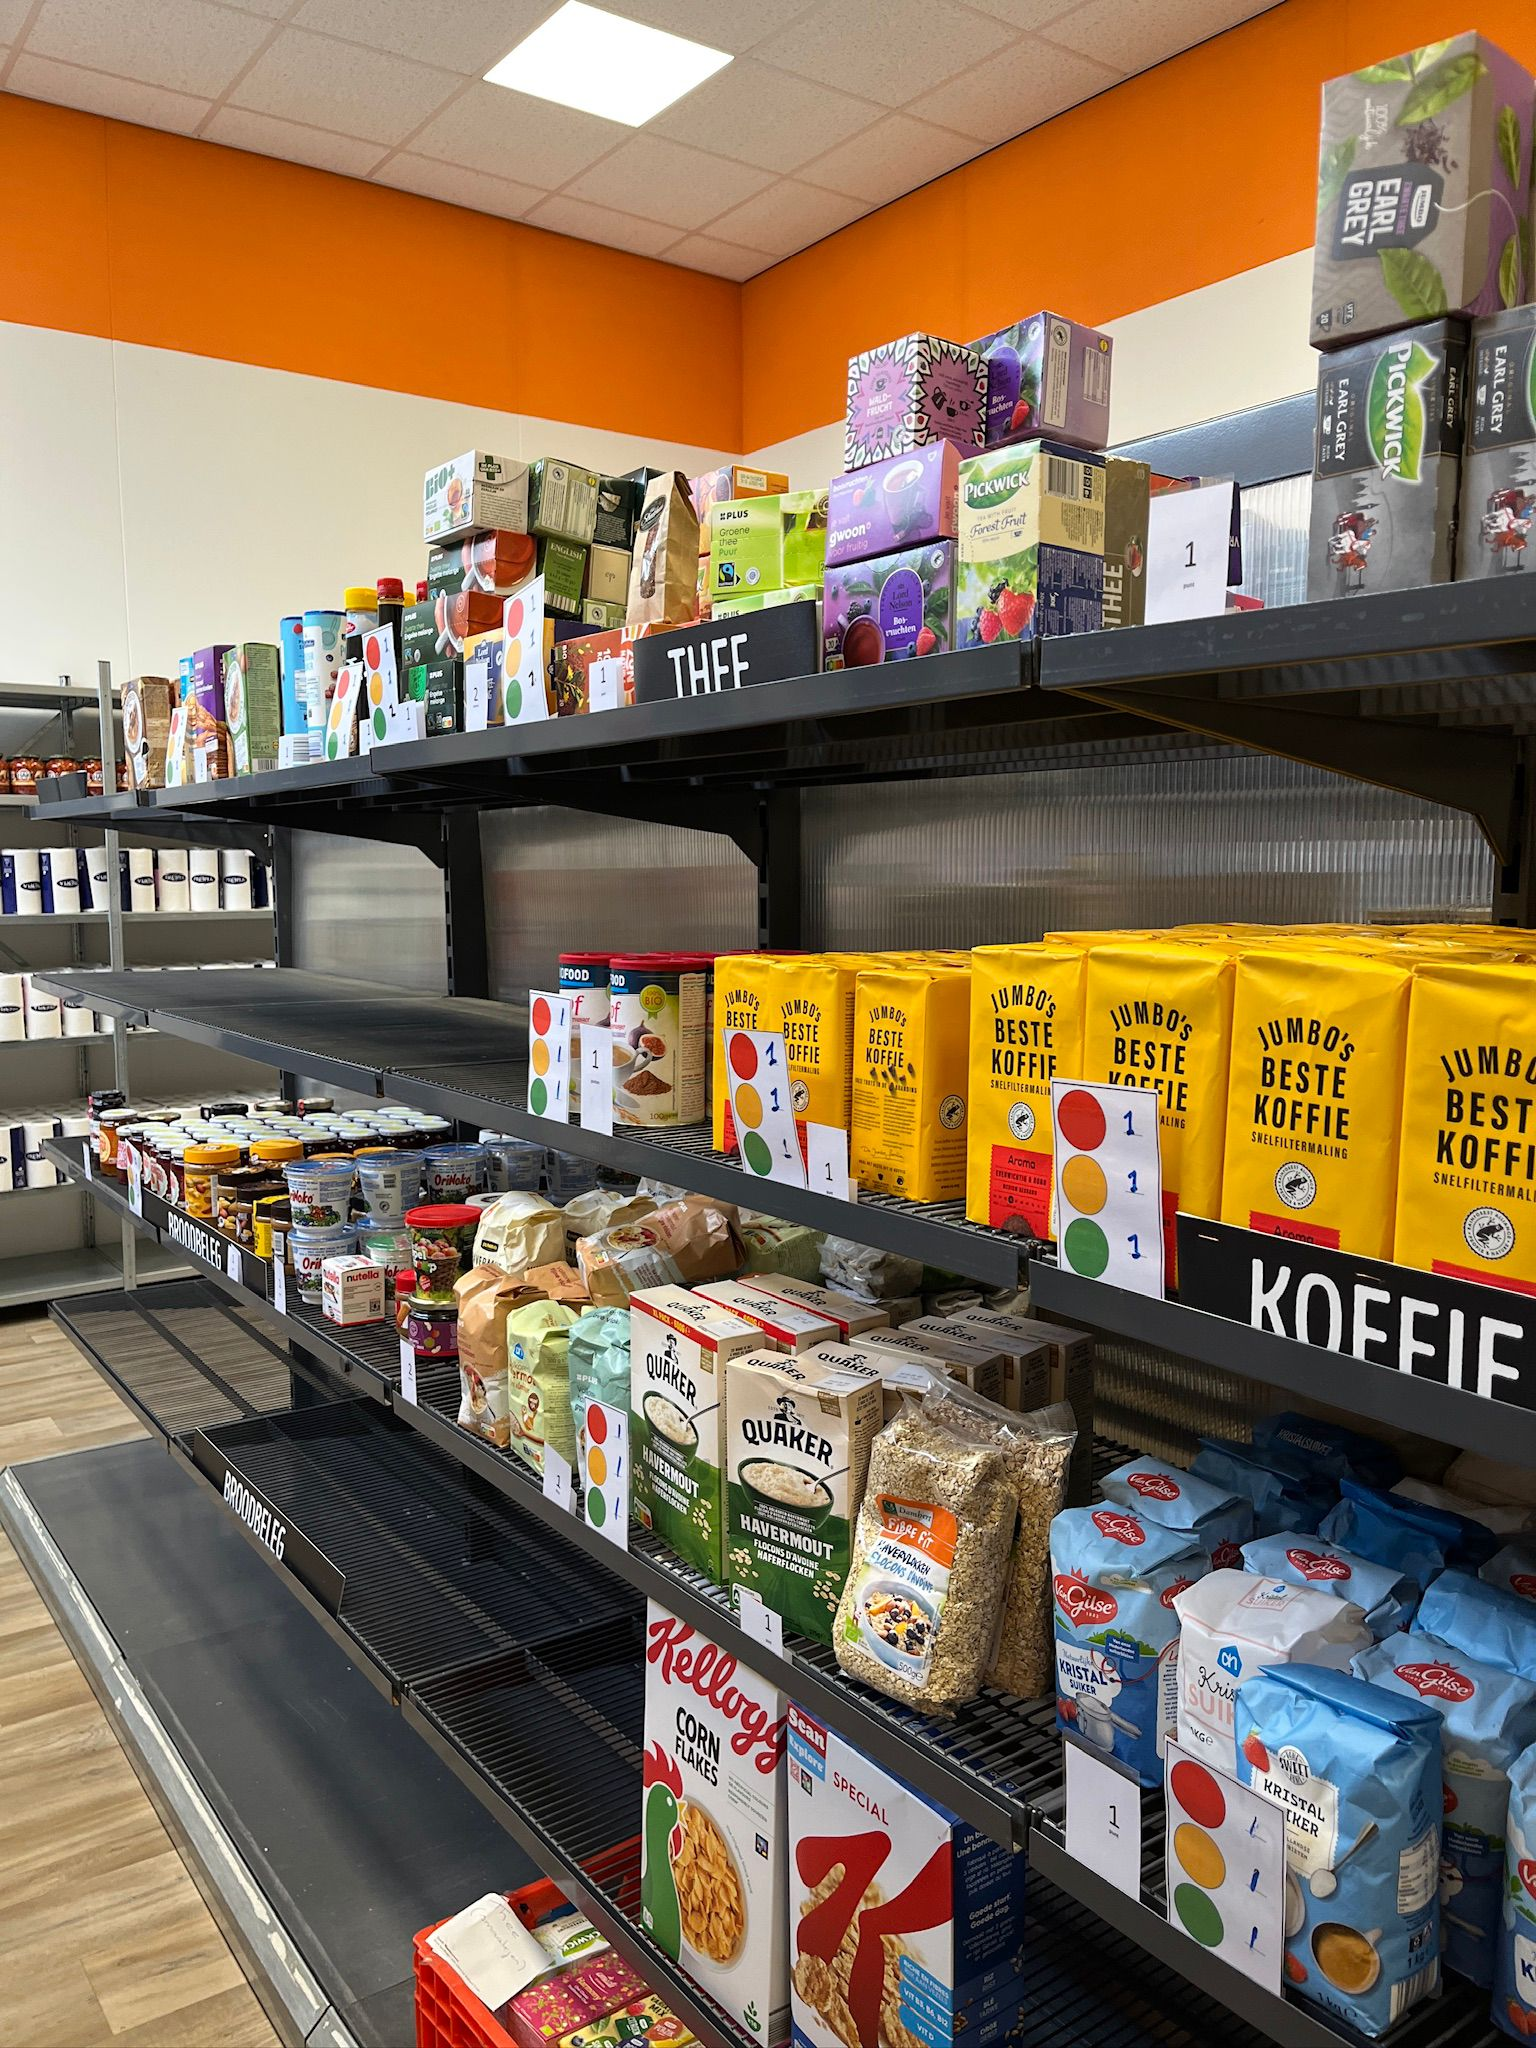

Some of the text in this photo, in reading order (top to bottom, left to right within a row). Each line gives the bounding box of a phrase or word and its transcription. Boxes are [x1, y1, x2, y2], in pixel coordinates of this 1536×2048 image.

[1341, 181, 1373, 245] GREY
[1368, 178, 1402, 244] EARL
[1446, 367, 1456, 428] EARL GREY
[1491, 345, 1507, 433] EARL GREY
[1335, 378, 1349, 461] EARL GREY
[1382, 340, 1412, 480] PICKWICK
[964, 471, 1029, 502] PICKWICK
[726, 509, 749, 520] PLUS
[970, 512, 1026, 538] Forest Fruit
[719, 527, 750, 537] Groene
[719, 537, 738, 546] thee
[550, 543, 582, 561] ENGLISH
[719, 547, 738, 557] Puur
[1185, 541, 1196, 568] 1
[1102, 561, 1123, 627] THEE
[645, 996, 663, 1006] BIO
[726, 1011, 757, 1029] BESTE
[784, 1021, 818, 1043] BESTE
[995, 1018, 1053, 1048] BESTE
[869, 1028, 903, 1048] BESTE
[766, 1041, 778, 1066] 1
[866, 1047, 904, 1068] KOFFIE
[1114, 1037, 1187, 1075] BESTE
[1261, 1056, 1347, 1099] BESTE
[770, 1087, 780, 1112] 1
[1123, 1110, 1135, 1135] 1
[1254, 1093, 1349, 1140] KOFFIE
[1251, 1131, 1348, 1159] SNELFILTERMALING
[825, 1162, 833, 1181] 1
[1007, 1154, 1036, 1169] Aroma
[1128, 1170, 1138, 1193] 1
[167, 1211, 222, 1270] BROODBELEG
[1127, 1233, 1141, 1259] 1
[346, 1270, 380, 1283] nutella
[733, 1297, 777, 1316] QUAKER
[782, 1288, 827, 1306] QUAKER
[666, 1302, 706, 1322] QUAKER
[966, 1314, 1023, 1331] QUAKER
[870, 1335, 930, 1352] QUAKER
[918, 1323, 977, 1342] QUAKER
[747, 1358, 806, 1381] QUAKER
[817, 1352, 880, 1378] QUAKER
[646, 1353, 697, 1406] QUAKER
[741, 1418, 833, 1467] QUAKER
[642, 1444, 700, 1498] HAVERMOUT
[651, 1482, 688, 1515] HAFERFLOCKEN
[1130, 1475, 1178, 1498] Van Gilse
[223, 1469, 287, 1561] BROODBELEG
[1095, 1512, 1141, 1543] Van Gilse
[740, 1513, 834, 1560] HAVERMOUT
[754, 1539, 819, 1571] FLOCONS D'AVOINE
[757, 1550, 815, 1579] HAFERFLOCKEN
[1290, 1550, 1347, 1578] Van Gilse
[1055, 1581, 1112, 1617] Van Gilse
[1059, 1658, 1107, 1685] KRISTAL
[1397, 1665, 1470, 1697] Van Gilse
[1070, 1679, 1096, 1695] SUIKER
[676, 1707, 720, 1765] CORN
[789, 1707, 825, 1750] Scan
[675, 1735, 717, 1787] FLAKES
[789, 1734, 824, 1773] Explore
[1280, 1758, 1309, 1778] SWEET
[833, 1772, 889, 1826] SPECIAL
[1264, 1779, 1325, 1822] KRISTAL
[1109, 1805, 1119, 1829] 1
[969, 1904, 991, 1920] Goede
[970, 1914, 993, 1929] Goede
[649, 2003, 665, 2017] MIX
[904, 1987, 914, 2000] VIT
[937, 2014, 948, 2028] B12
[917, 2023, 928, 2036] VIT
